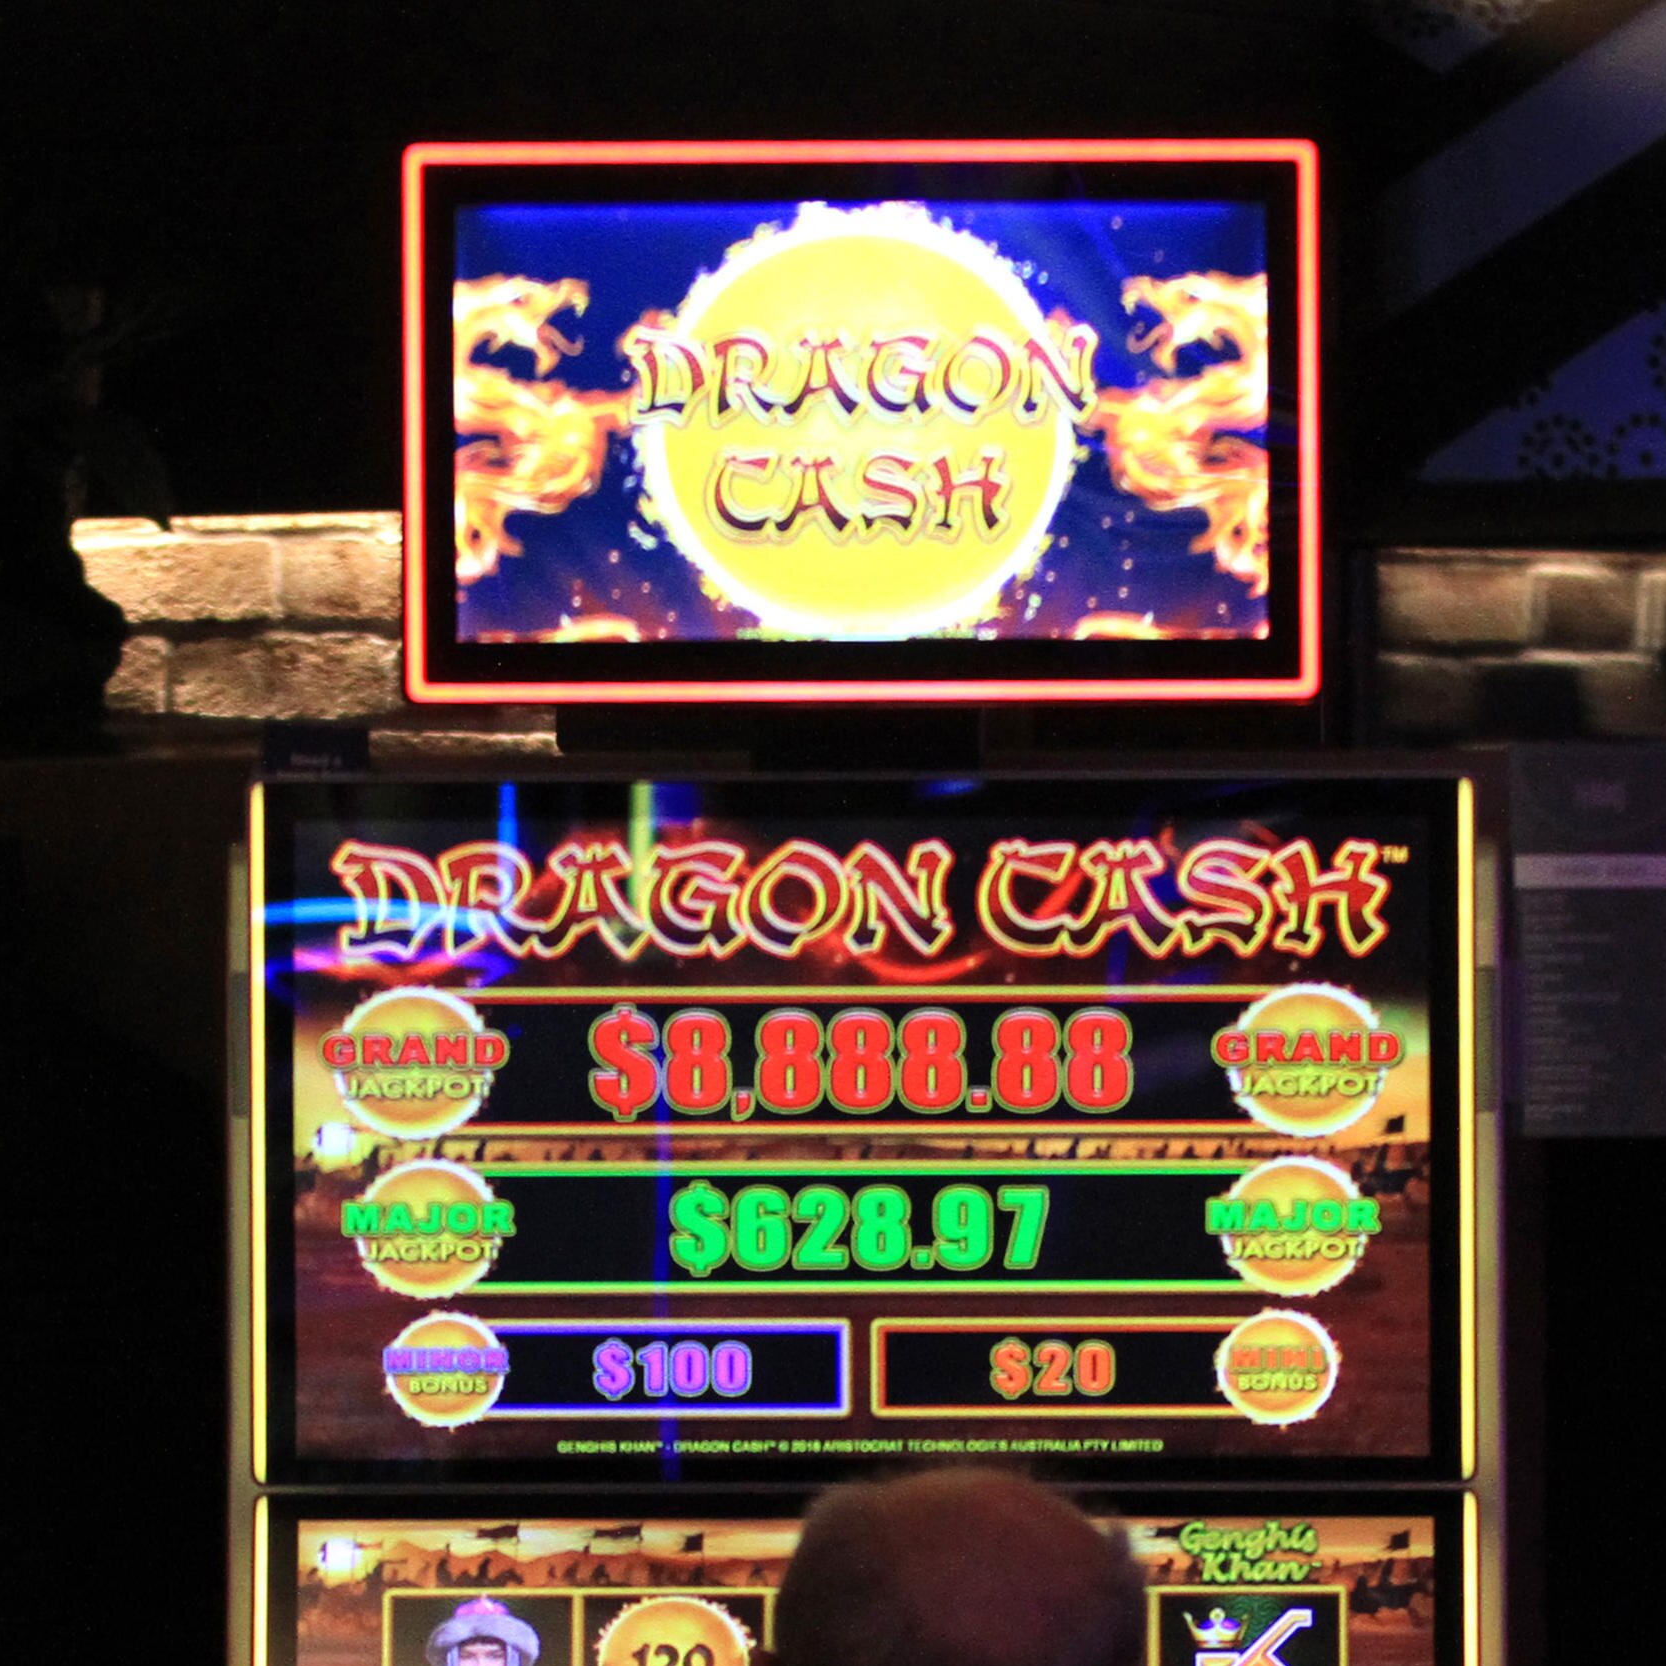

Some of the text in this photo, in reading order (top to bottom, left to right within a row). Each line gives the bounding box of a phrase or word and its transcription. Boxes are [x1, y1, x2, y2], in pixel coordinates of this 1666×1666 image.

[630, 325, 1100, 430] DRAGON
[707, 445, 1013, 543] CASH
[333, 839, 953, 961] DRAGON
[979, 839, 1391, 958] CASH
[319, 1029, 510, 1070] GRAND
[588, 1003, 1135, 1122] $8,888.88
[1211, 1027, 1406, 1068] GRAND
[347, 1073, 495, 1099] JACKPOT
[1240, 1071, 1383, 1096] JACKPOT
[341, 1200, 517, 1237] MAJOR
[669, 1180, 1050, 1277] $628.97
[1205, 1197, 1382, 1235] MAJOR
[364, 1239, 503, 1262] JACKPOT
[1231, 1237, 1367, 1261] JACKPOT
[382, 1347, 510, 1375] MINOR
[593, 1338, 753, 1400] $100
[990, 1335, 1116, 1399] $20
[1230, 1348, 1328, 1373] MINI
[407, 1377, 489, 1394] BONUS
[1237, 1374, 1319, 1392] BONUS
[1111, 1440, 1164, 1451] LIMITED
[1179, 1521, 1318, 1559] Genghis
[1202, 1551, 1310, 1583] Khan
